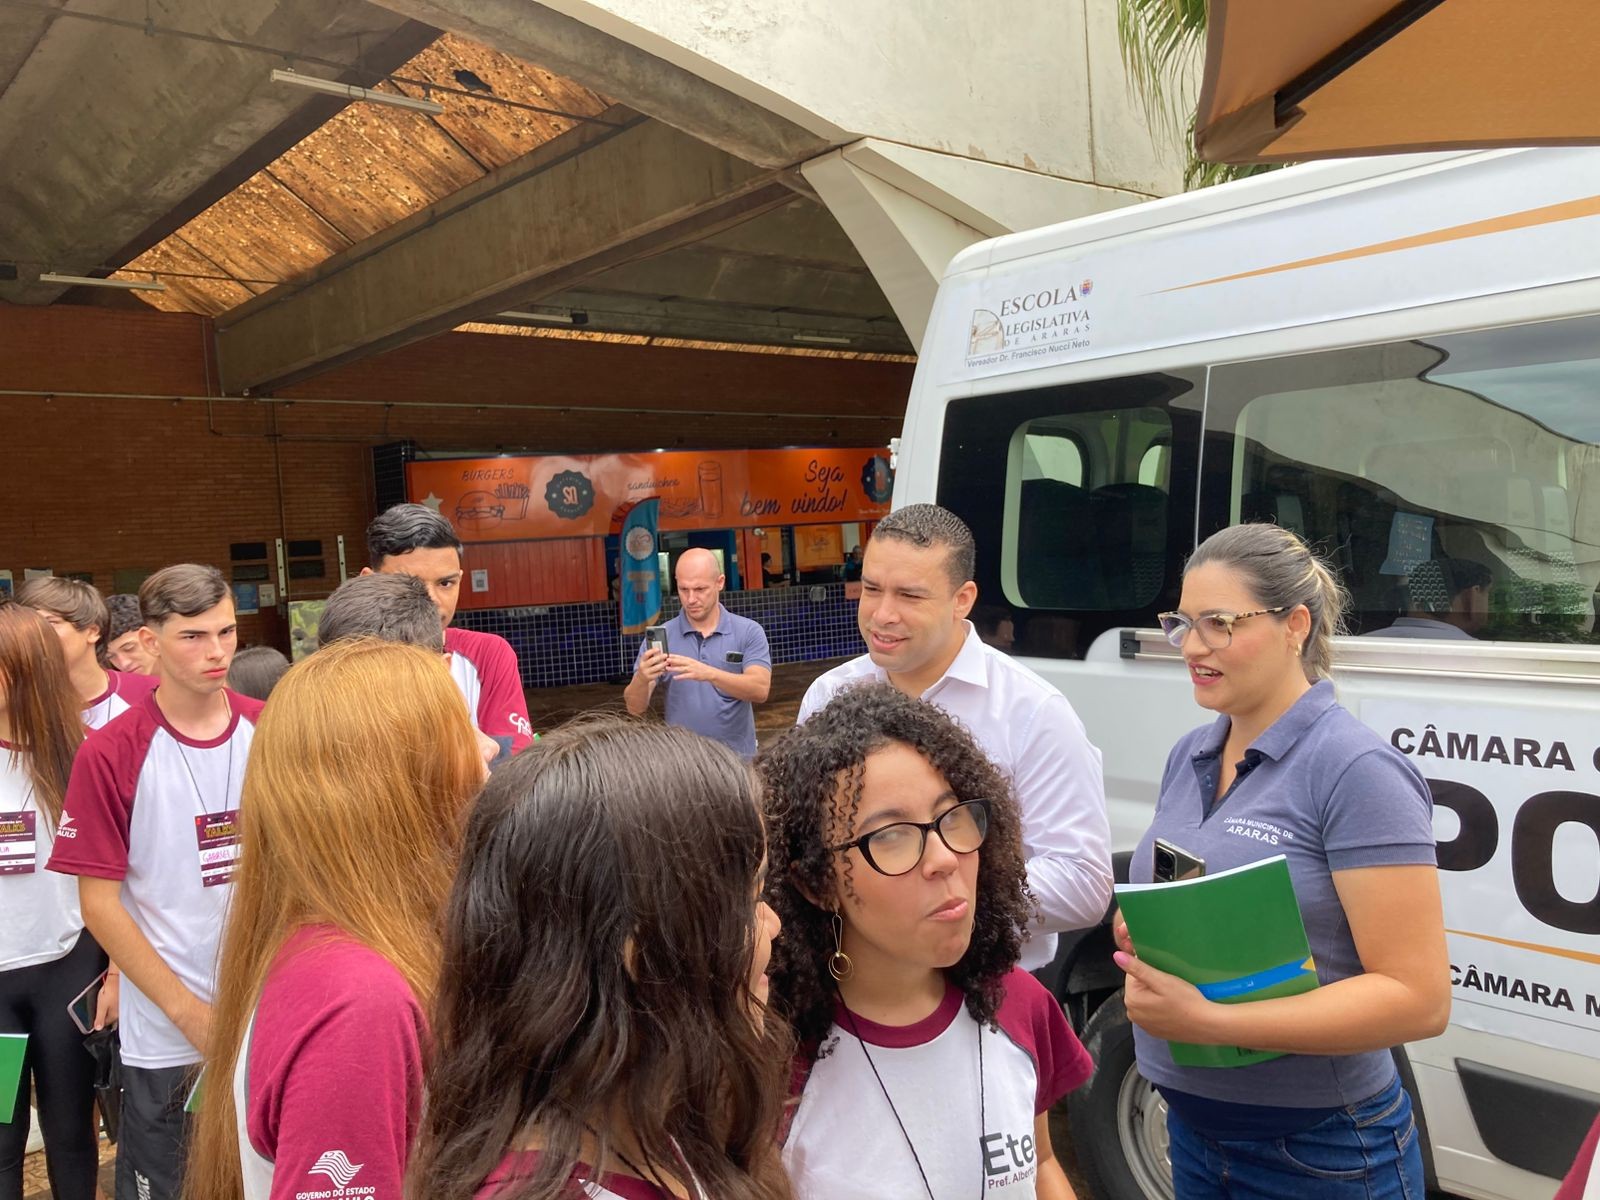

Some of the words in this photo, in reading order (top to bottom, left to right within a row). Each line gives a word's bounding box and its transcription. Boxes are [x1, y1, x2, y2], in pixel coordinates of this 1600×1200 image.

[1000, 286, 1078, 317] ESCOLA
[1006, 309, 1090, 336] LEGISLATIVA
[1031, 323, 1091, 341] ARARAS
[967, 354, 998, 368] Vereador
[999, 352, 1009, 362] Dr.
[1011, 346, 1047, 360] Francisco
[1048, 342, 1070, 355] Nucci
[1071, 338, 1090, 349] Neto
[461, 468, 514, 482] BURGERS
[804, 459, 845, 492] Seja
[739, 489, 782, 517] bem
[791, 489, 848, 514] vindo!
[1391, 724, 1575, 771] CÂMARA
[1226, 825, 1279, 845] ARARAS
[1246, 819, 1281, 835] MUNICIPAL
[1282, 829, 1294, 839] DE
[1450, 964, 1575, 1012] CÂMARA
[296, 1191, 331, 1200] GOVERNO
[333, 1189, 344, 1197] DO
[346, 1187, 375, 1196] ESTADO
[988, 1175, 1011, 1190] Pref.
